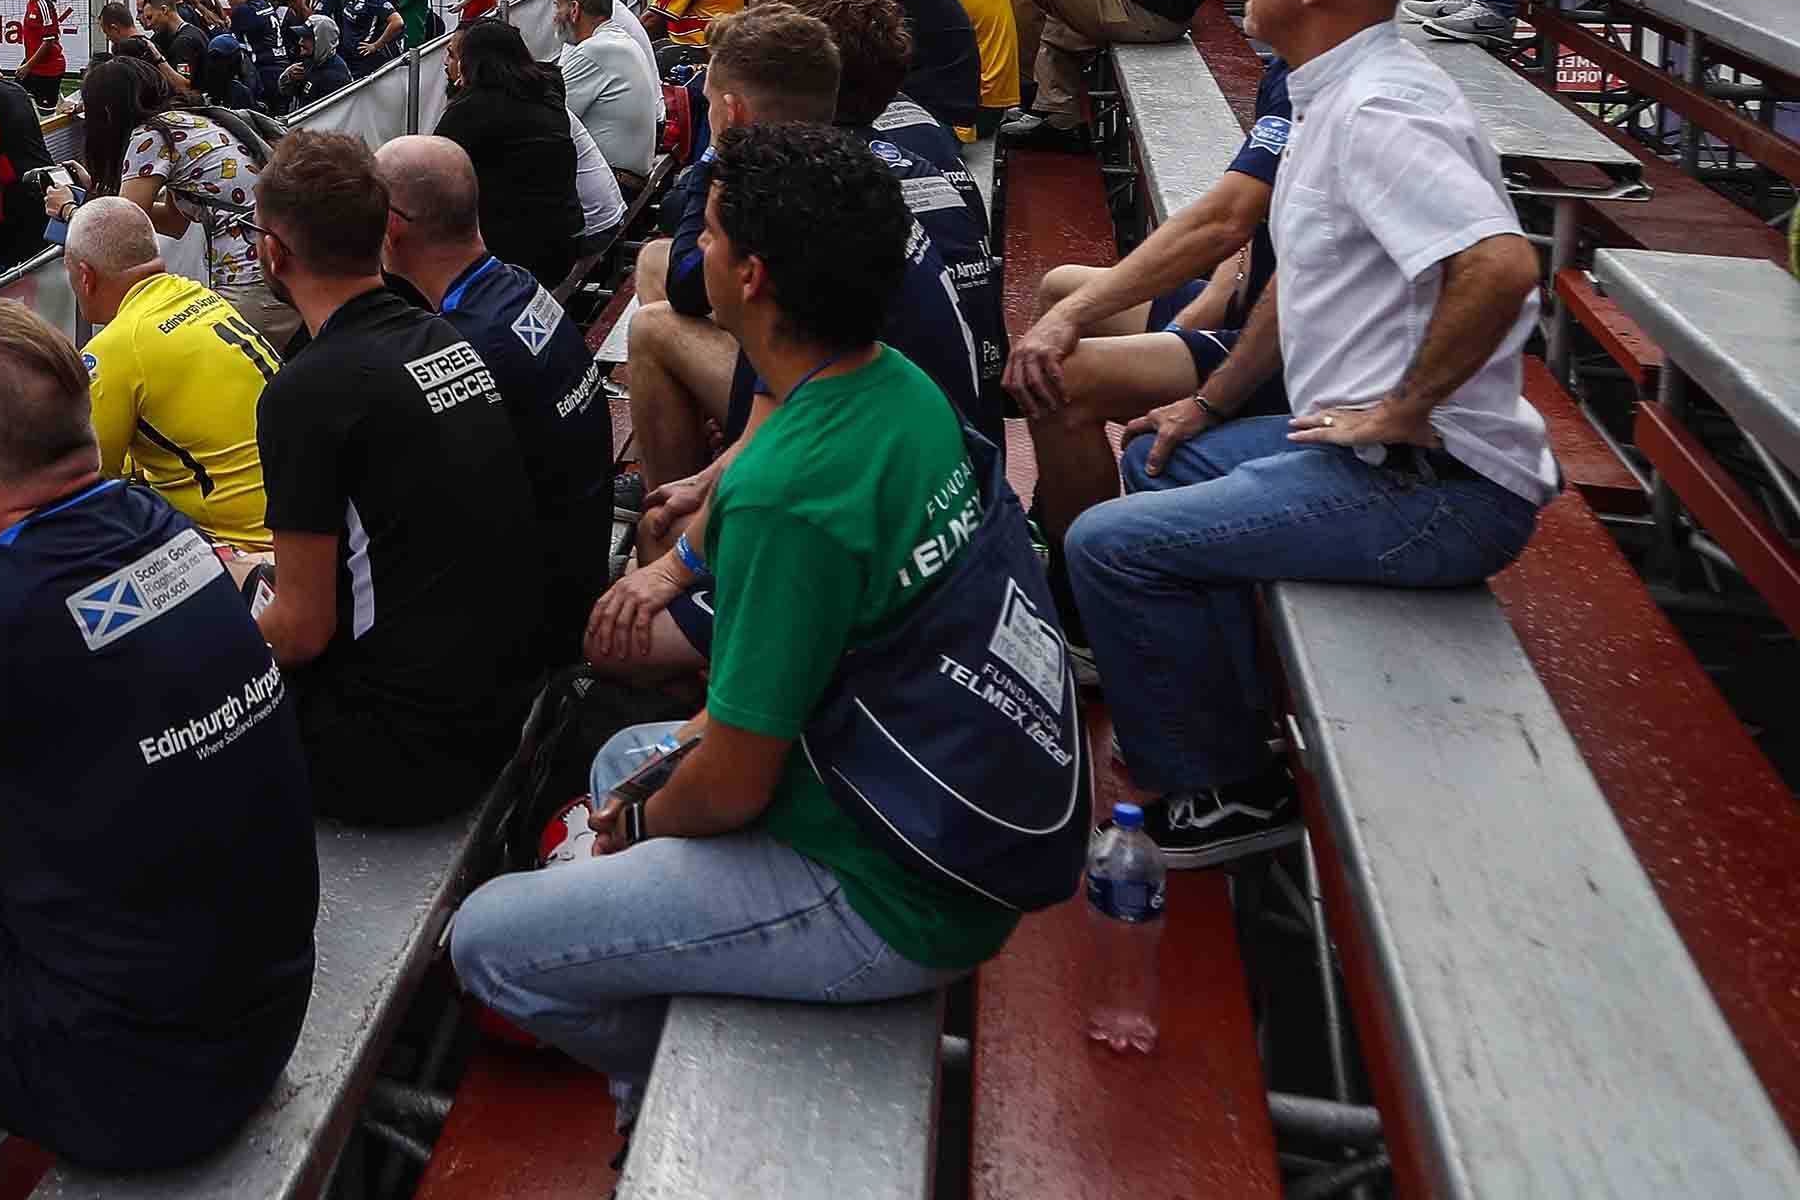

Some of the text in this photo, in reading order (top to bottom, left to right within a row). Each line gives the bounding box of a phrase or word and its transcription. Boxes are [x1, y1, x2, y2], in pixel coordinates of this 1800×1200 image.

[139, 696, 244, 765] Edinburgh
[938, 654, 1027, 728] TELMEX
[1025, 721, 1073, 768] telcel
